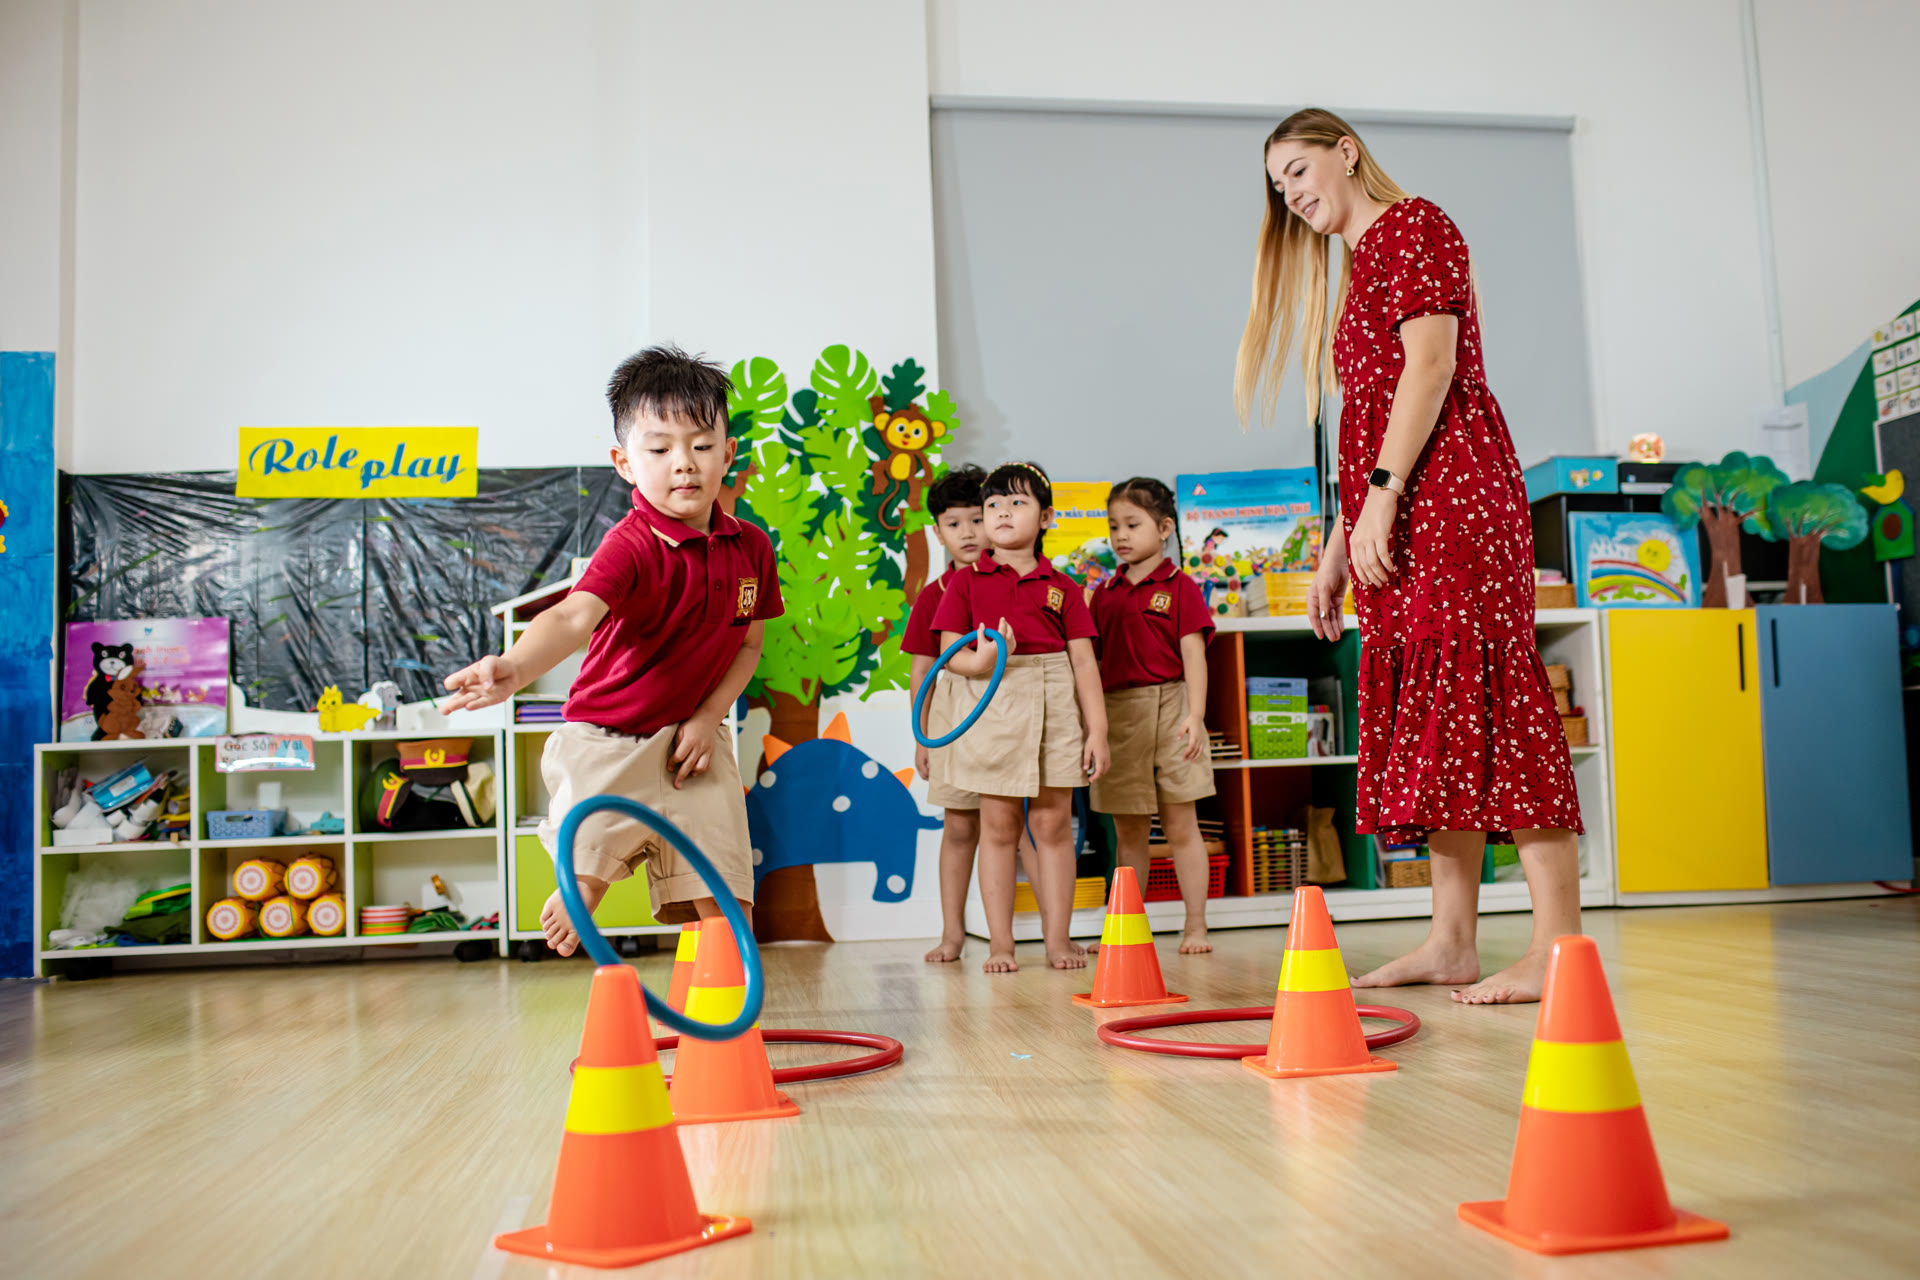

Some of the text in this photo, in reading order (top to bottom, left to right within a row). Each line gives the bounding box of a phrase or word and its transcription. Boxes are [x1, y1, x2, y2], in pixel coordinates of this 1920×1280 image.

[249, 434, 465, 490] Role play
[1202, 508, 1236, 520] TRANH
[1238, 505, 1265, 517] MINH
[283, 739, 303, 751] Vai
